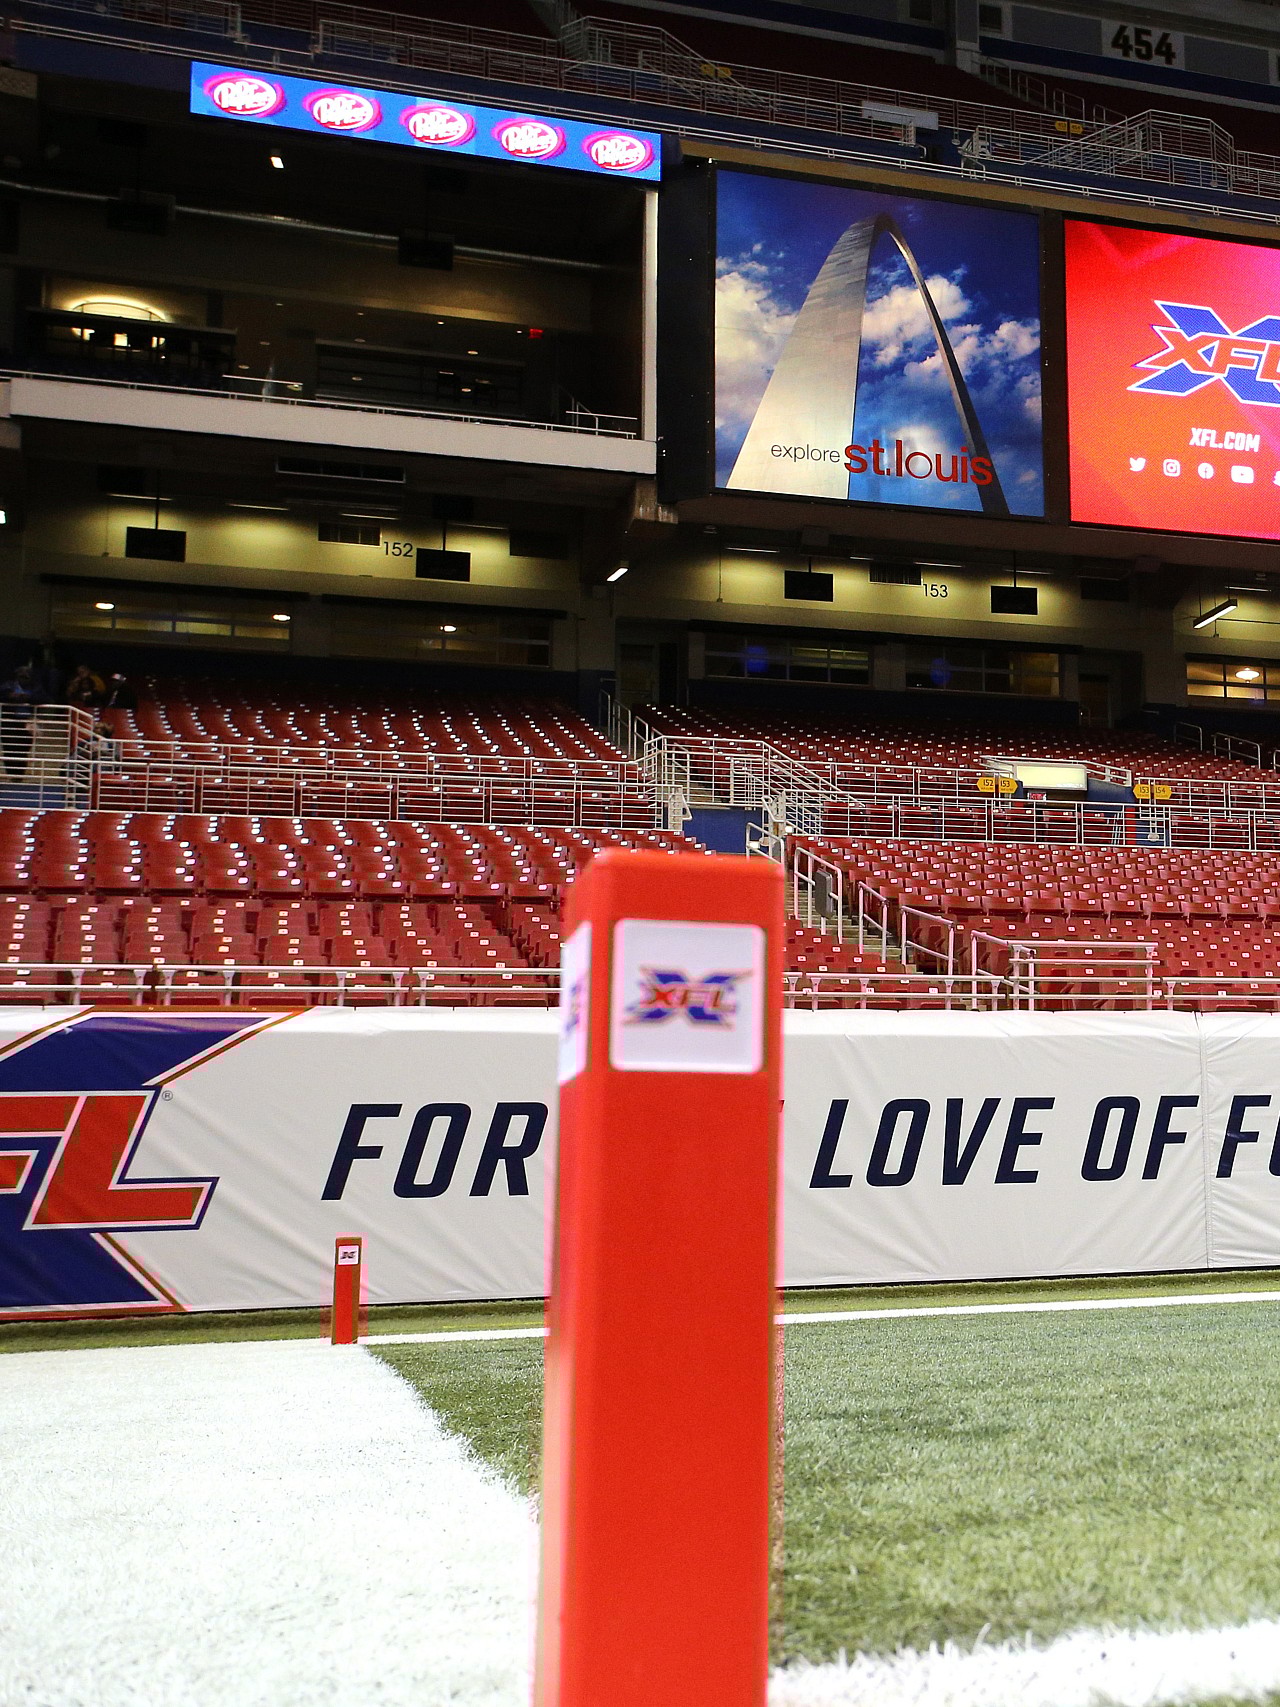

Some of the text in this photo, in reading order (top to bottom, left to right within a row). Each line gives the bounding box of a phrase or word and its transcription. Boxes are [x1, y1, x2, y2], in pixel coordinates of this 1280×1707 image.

[1111, 25, 1176, 65] 454
[1189, 427, 1260, 452] XFL.COM
[771, 439, 993, 486] explore st.louis
[384, 541, 413, 558] 152
[923, 583, 949, 598] 153
[321, 1102, 549, 1200] FOR
[809, 1097, 1055, 1188] LOVE
[1081, 1095, 1199, 1181] OF
